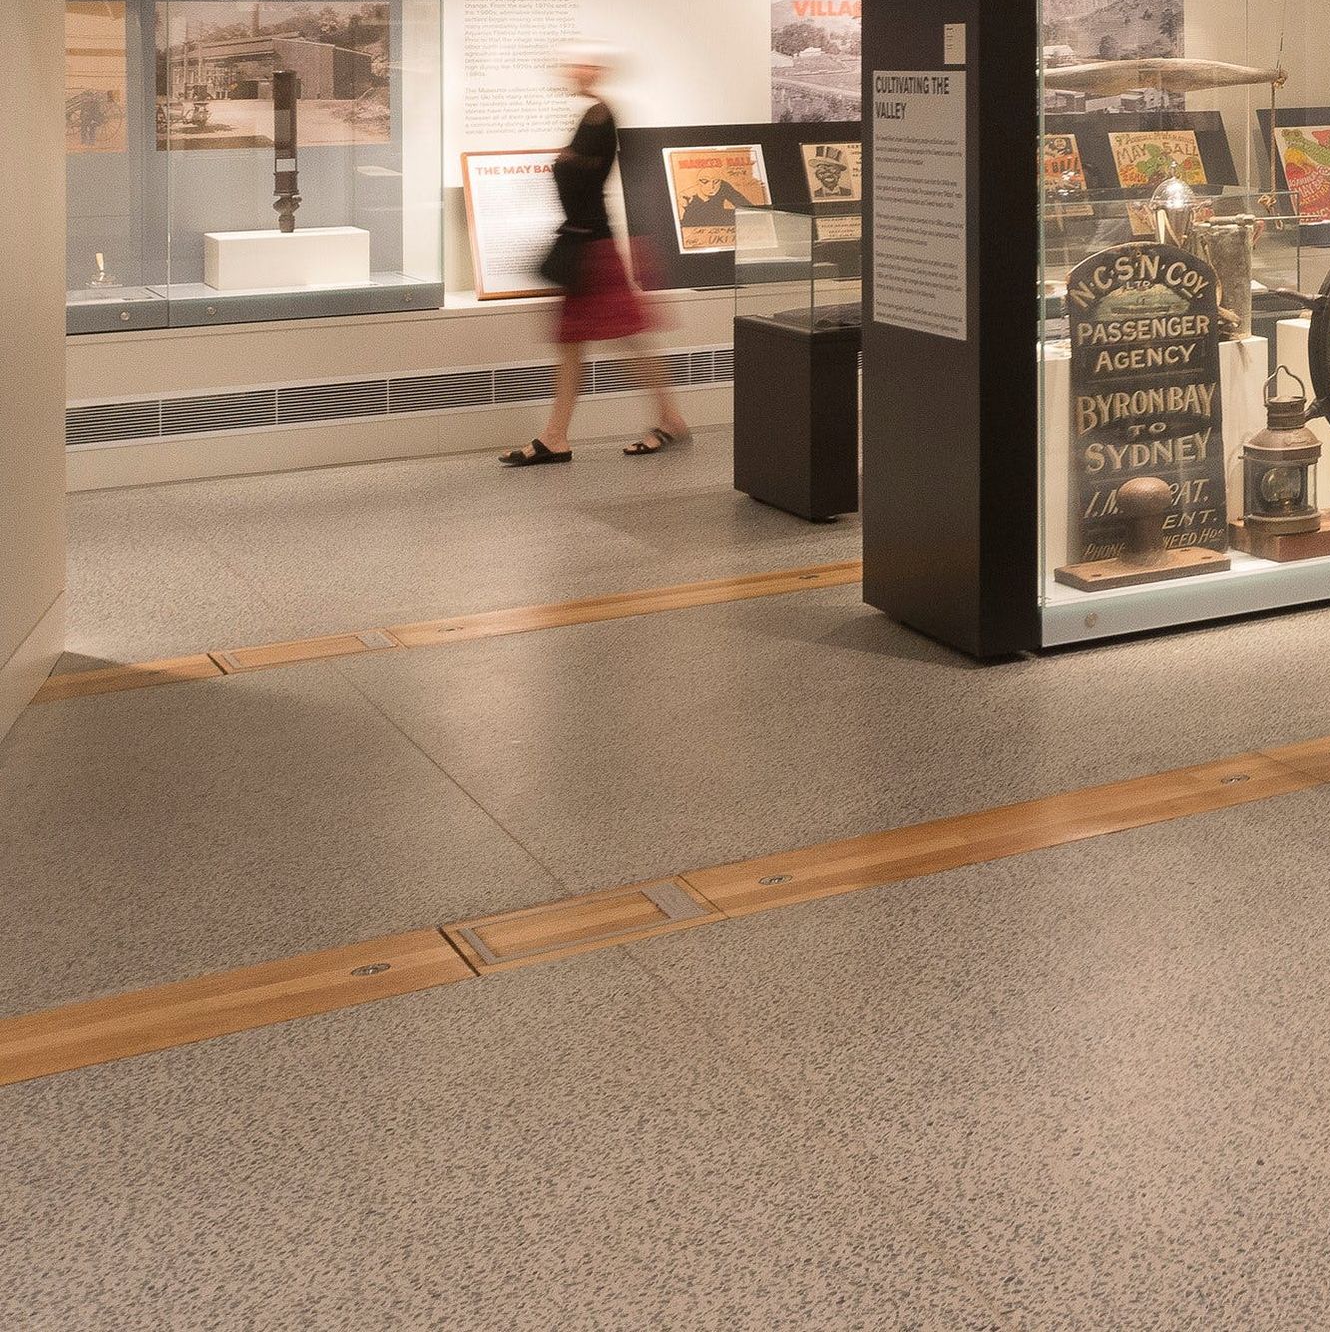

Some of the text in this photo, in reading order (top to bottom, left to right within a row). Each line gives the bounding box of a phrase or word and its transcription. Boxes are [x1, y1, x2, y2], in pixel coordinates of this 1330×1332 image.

[875, 76, 950, 96] CULTIVATING THE
[875, 101, 907, 121] VALLEY
[474, 167, 501, 176] THE
[503, 165, 532, 175] MAY
[1077, 314, 1211, 347] PASSENGER
[1095, 342, 1197, 373] AGENCY
[1075, 381, 1217, 438] BYRON BAY
[1127, 421, 1168, 437] TO
[1084, 426, 1213, 473] SYDNEY
[1162, 531, 1198, 550] WEED
